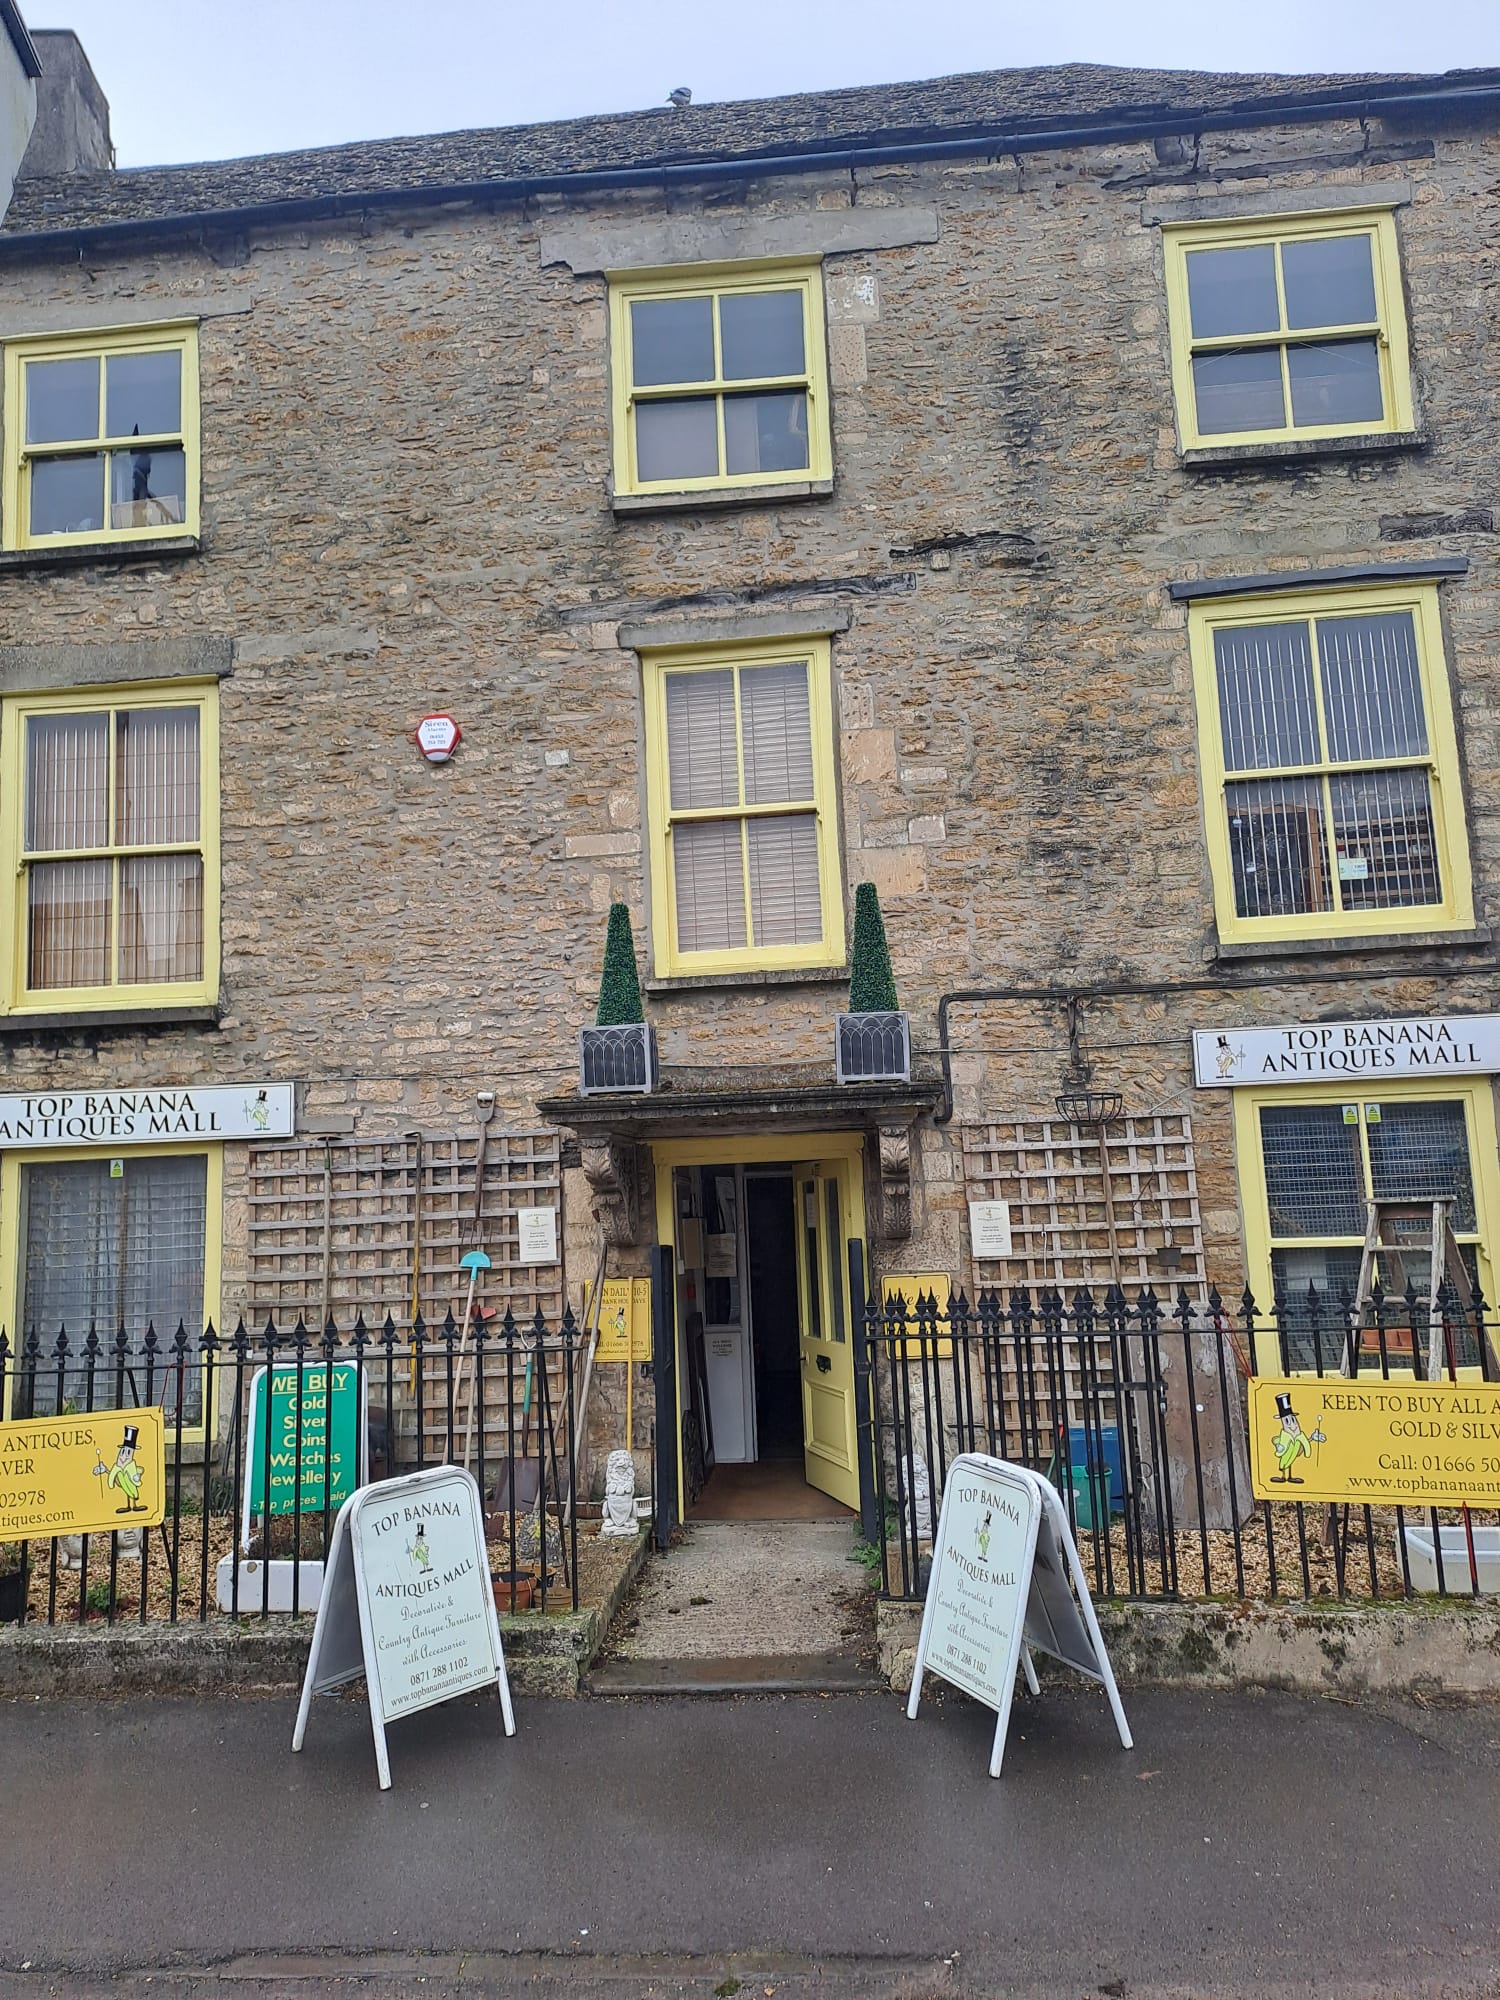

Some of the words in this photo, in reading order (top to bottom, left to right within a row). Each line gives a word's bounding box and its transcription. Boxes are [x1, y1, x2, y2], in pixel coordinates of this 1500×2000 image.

[1282, 1030, 1333, 1050] TOP
[1343, 1023, 1453, 1047] BANANA
[1262, 1048, 1395, 1073] ANTIQUES
[1408, 1043, 1481, 1065] MALL
[21, 1097, 73, 1118] TOP
[84, 1093, 195, 1116] BANANA
[0, 1115, 135, 1140] ANTIQUES
[149, 1112, 222, 1134] MALL
[308, 1373, 348, 1390] BUY
[1322, 1393, 1371, 1411] KEEN
[1375, 1395, 1402, 1412] TO
[1406, 1396, 1445, 1413] BUY
[1450, 1397, 1487, 1414] ALL
[283, 1415, 327, 1430] Siver
[1389, 1420, 1441, 1438] GOLD
[1446, 1422, 1458, 1438] &
[4, 1429, 96, 1452] ANTIQUES,
[1378, 1453, 1417, 1470] Call:
[1422, 1455, 1475, 1472] 01666
[269, 1470, 341, 1489] Jewelley
[0, 1489, 46, 1508] 02978
[259, 1500, 277, 1513] Tp
[282, 1496, 317, 1511] prces
[323, 1491, 346, 1505] aid
[958, 1488, 978, 1503] TOP
[980, 1489, 1020, 1527] BANANA
[371, 1512, 399, 1536] TOP
[404, 1501, 461, 1522] BANANA
[375, 1576, 440, 1598] ANTIQUES
[443, 1558, 474, 1585] MALL
[946, 1545, 990, 1583] ANTIQUES
[991, 1572, 1016, 1586] MALL
[401, 1602, 446, 1621] Decorative
[447, 1595, 454, 1606] &
[378, 1634, 411, 1651] Country
[411, 1624, 444, 1640] Antique
[444, 1611, 482, 1629] Furniture
[402, 1648, 419, 1666] with
[420, 1638, 467, 1660] Accessories
[410, 1669, 430, 1686] 0871
[449, 1656, 469, 1672] 1102
[973, 1658, 987, 1675] 1102
